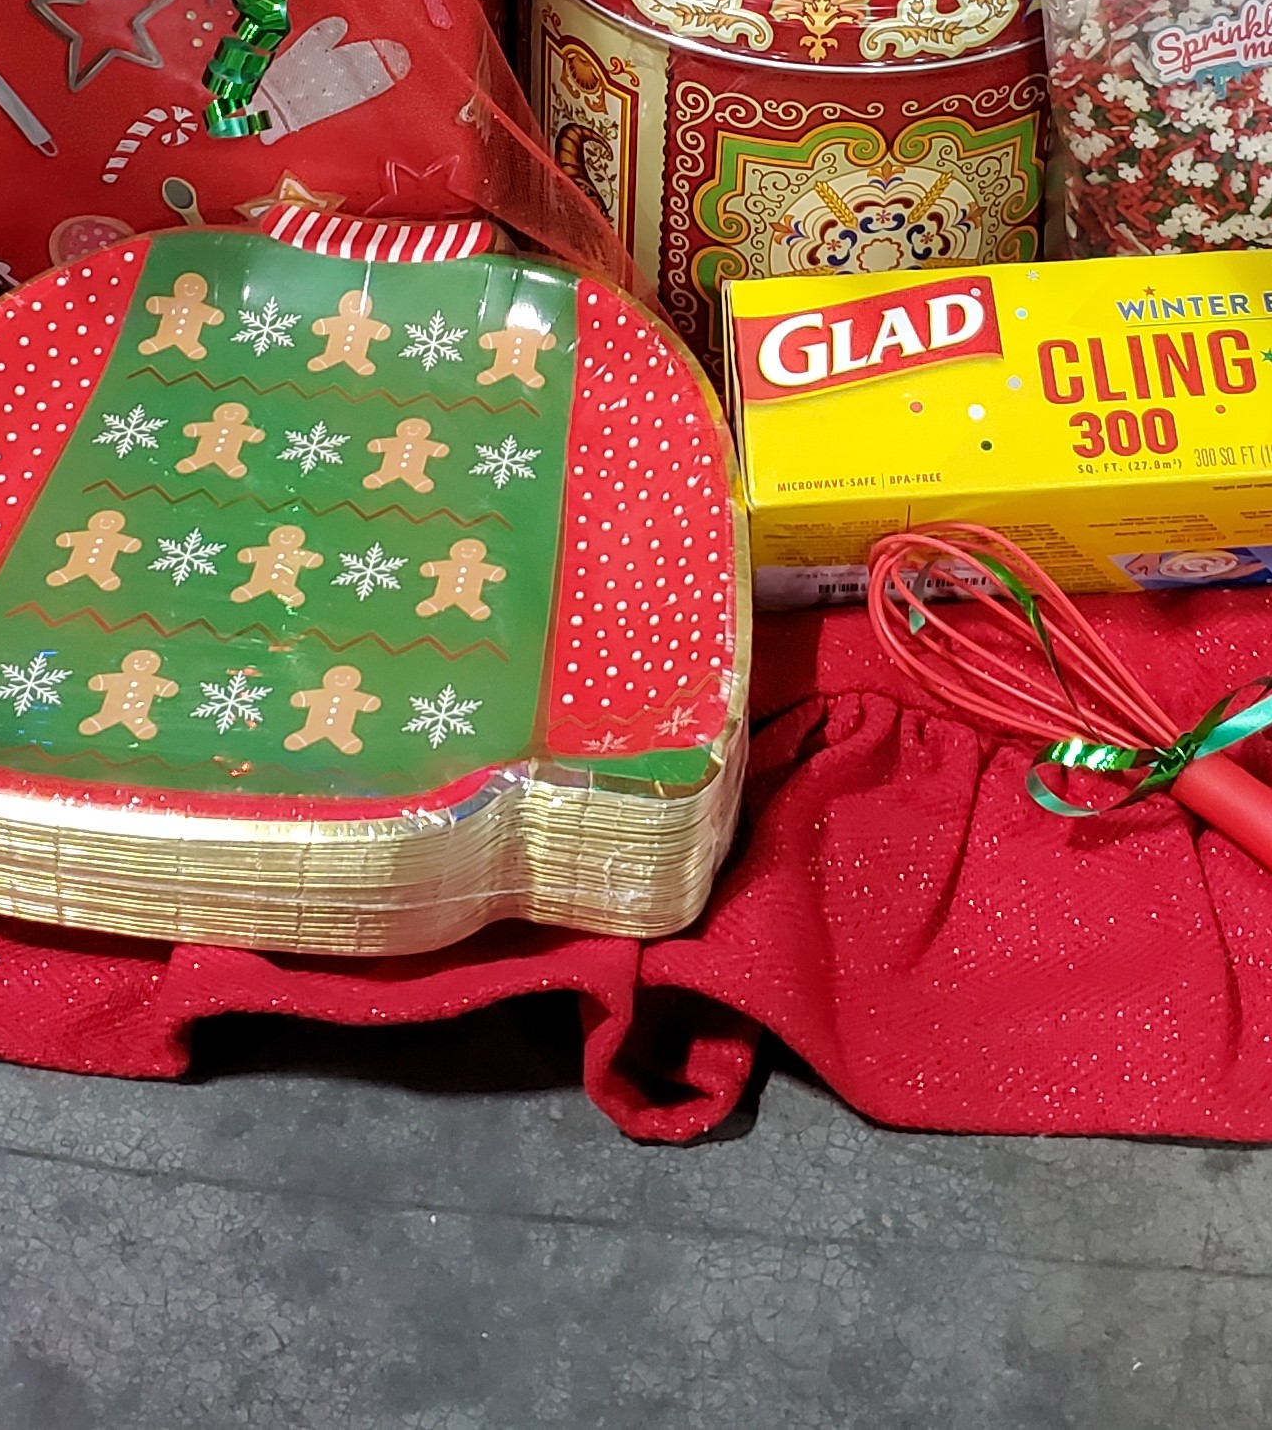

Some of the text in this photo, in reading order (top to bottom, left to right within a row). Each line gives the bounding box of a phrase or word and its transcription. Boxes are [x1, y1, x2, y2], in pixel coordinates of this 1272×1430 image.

[1116, 292, 1251, 322] WINTER
[757, 292, 985, 388] GLAD
[1037, 328, 1257, 405] CLING
[1068, 407, 1179, 459] 300
[1077, 463, 1100, 475] SQ.
[1103, 462, 1124, 473] FT.
[1193, 447, 1217, 468] 300
[1219, 446, 1237, 467] SQ
[1240, 445, 1258, 466] FT
[777, 472, 943, 493] MICROWAVE-SAFE BPA-FREE
